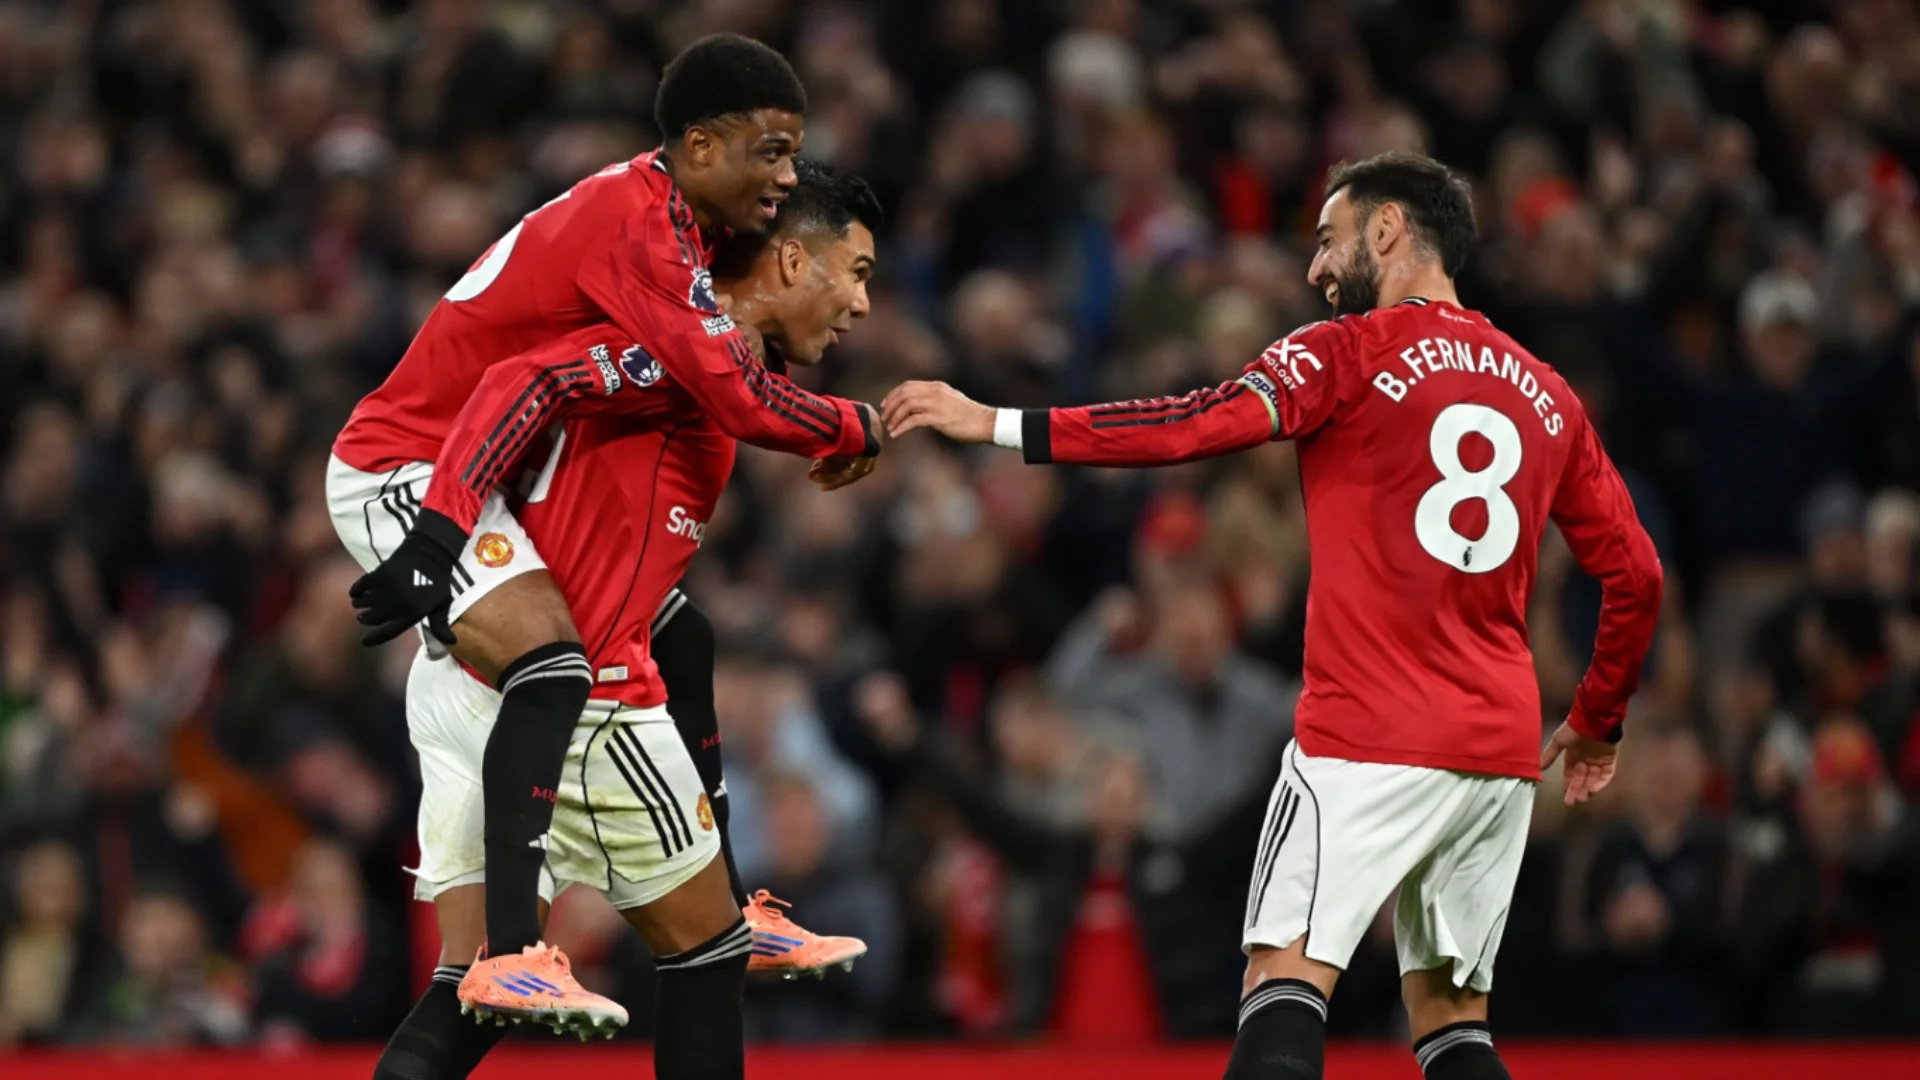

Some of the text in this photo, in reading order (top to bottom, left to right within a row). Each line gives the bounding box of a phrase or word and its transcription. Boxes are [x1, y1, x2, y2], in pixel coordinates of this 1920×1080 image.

[1263, 337, 1323, 385] XC
[1372, 337, 1564, 437] B.FERNANDES
[1414, 403, 1523, 574] 8
